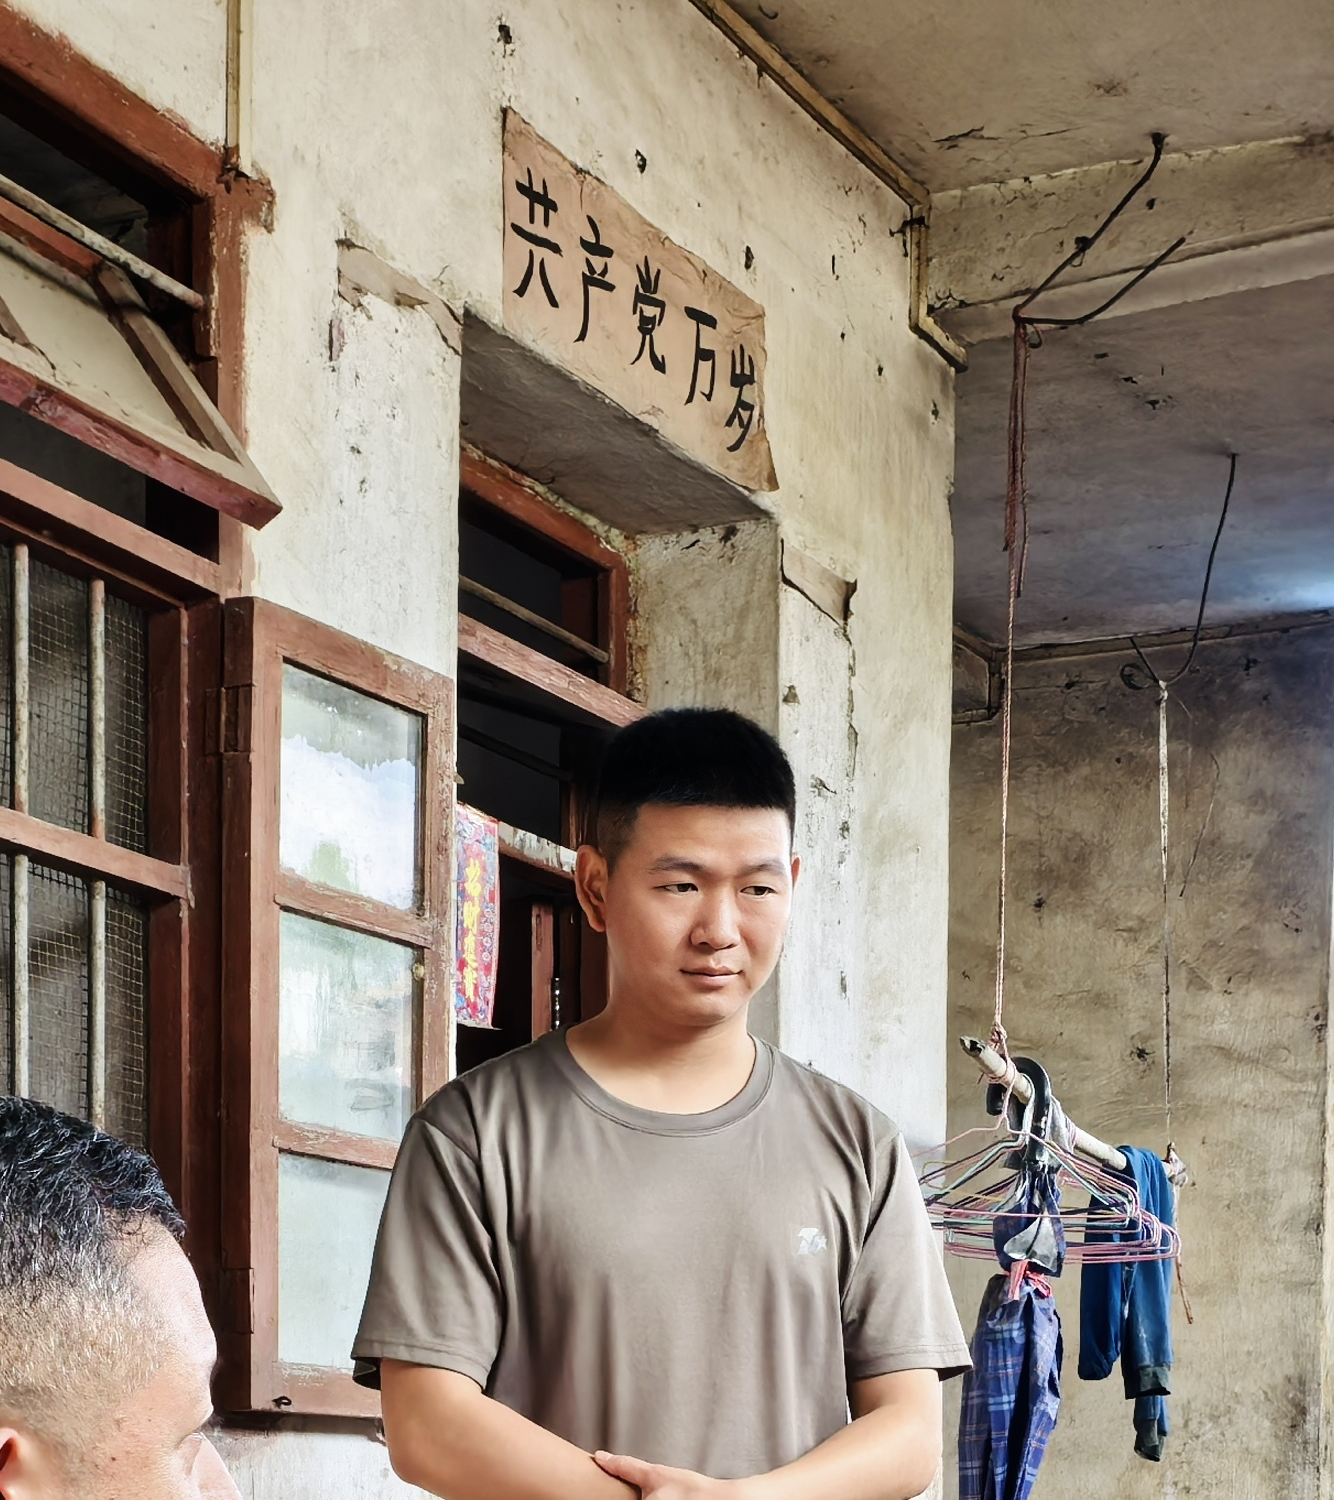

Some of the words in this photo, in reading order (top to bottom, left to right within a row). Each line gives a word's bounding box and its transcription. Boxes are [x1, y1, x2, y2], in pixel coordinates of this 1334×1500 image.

[510, 166, 756, 453] 共产党万岁
